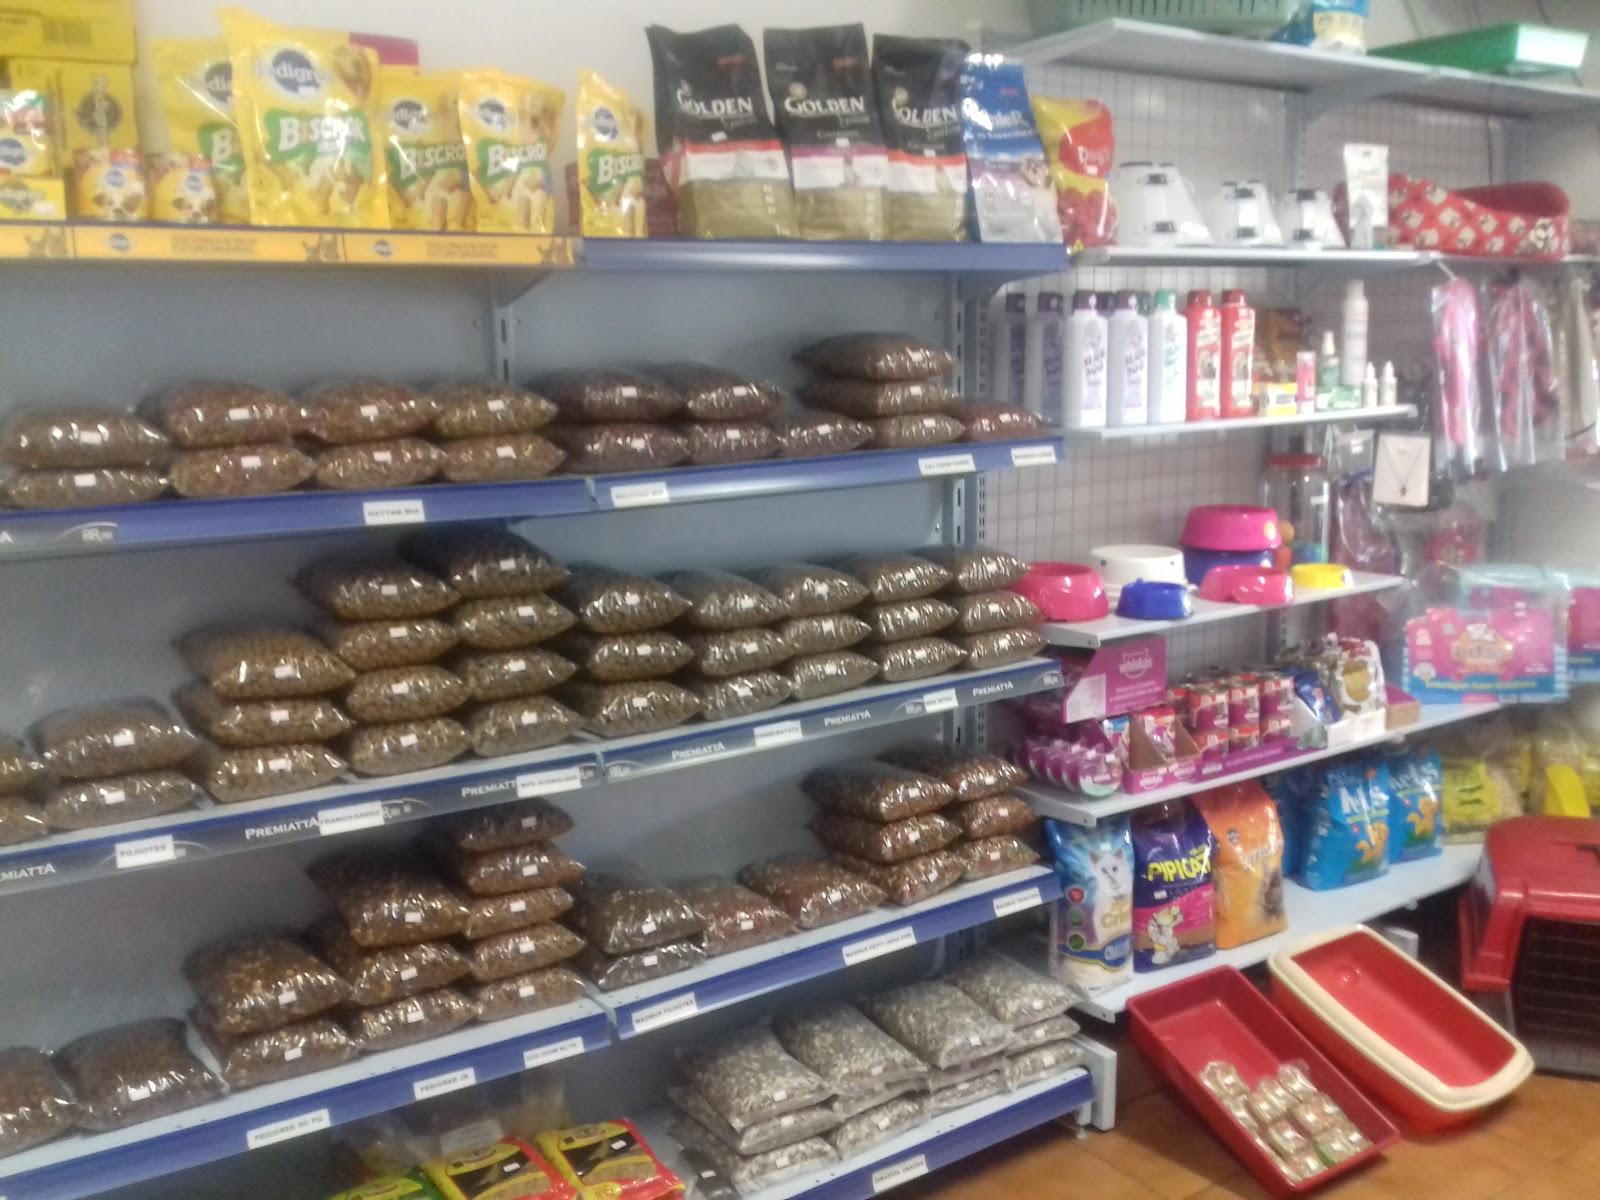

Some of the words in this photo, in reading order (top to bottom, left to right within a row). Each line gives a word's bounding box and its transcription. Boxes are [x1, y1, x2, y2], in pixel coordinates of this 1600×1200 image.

[784, 96, 866, 114] GOLDEN
[971, 680, 1015, 697] PREMIATTA
[823, 709, 872, 727] PREMIATTA
[671, 741, 727, 761] PREMIATTA
[461, 779, 517, 798] PREMIATT
[244, 815, 320, 840] PREMIATTA
[0, 862, 57, 882] MIATTA
